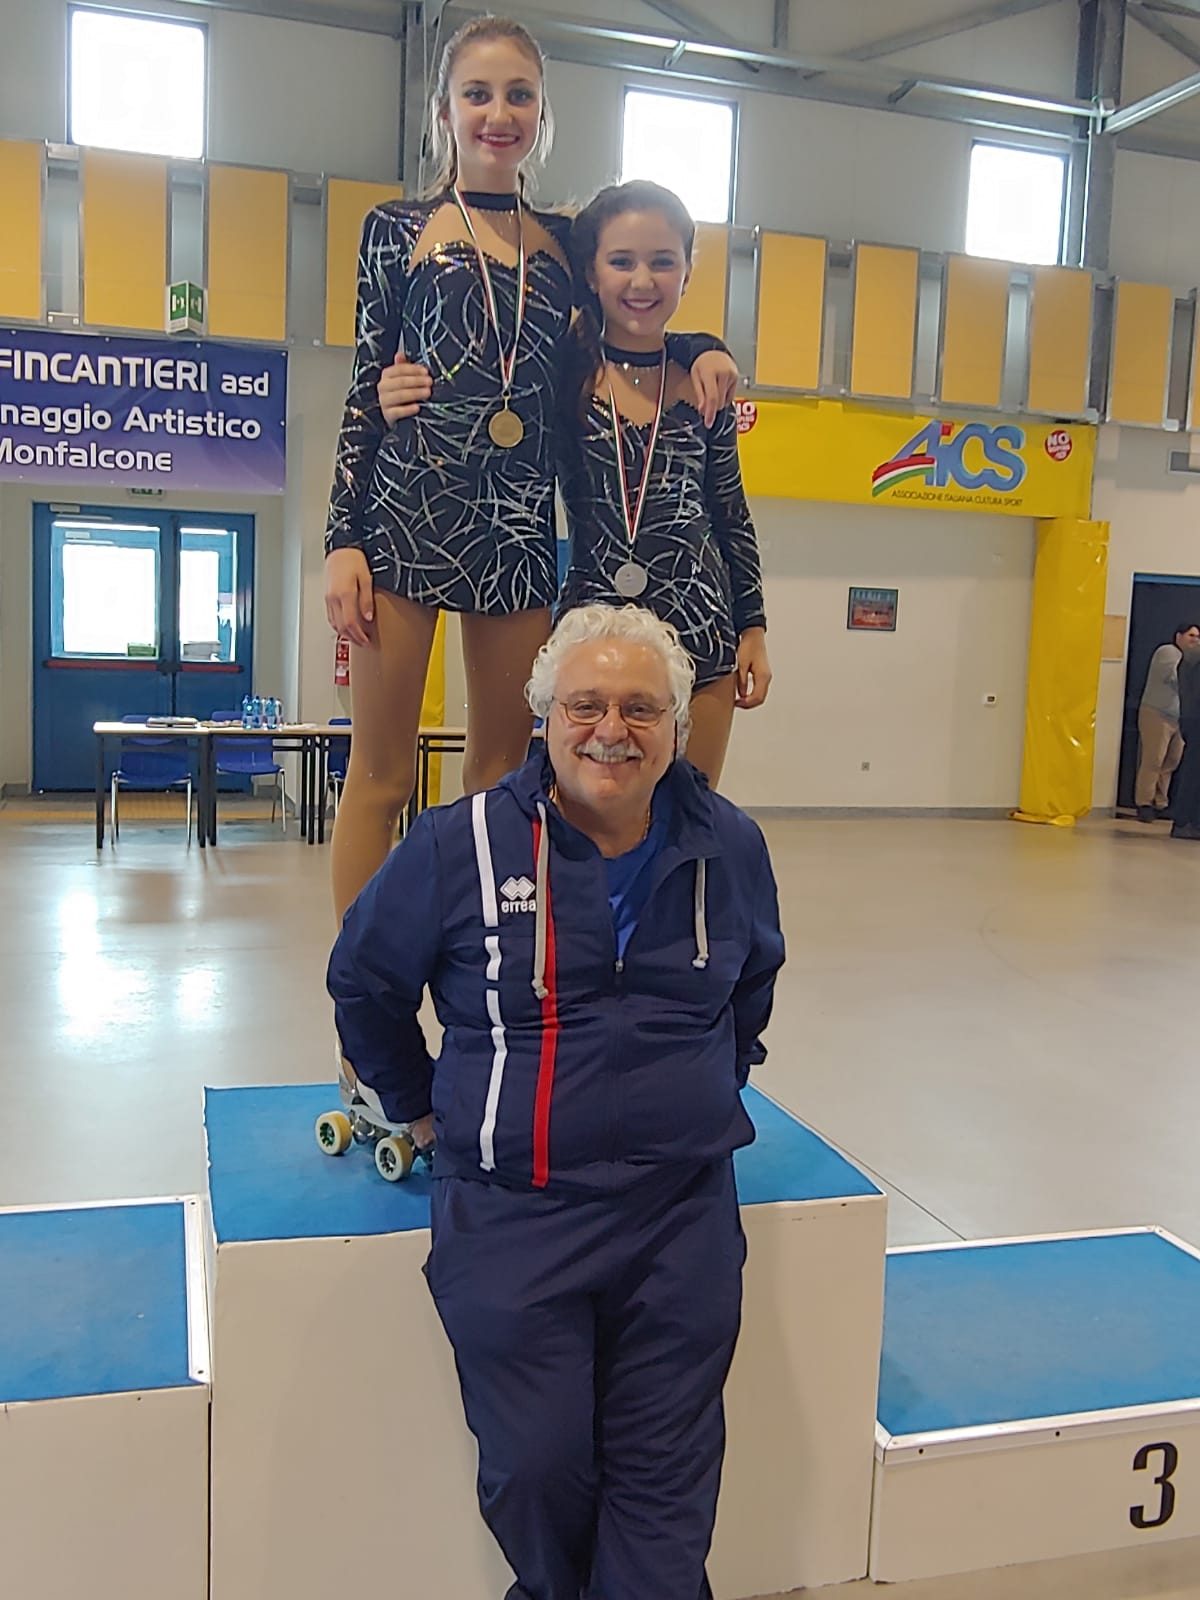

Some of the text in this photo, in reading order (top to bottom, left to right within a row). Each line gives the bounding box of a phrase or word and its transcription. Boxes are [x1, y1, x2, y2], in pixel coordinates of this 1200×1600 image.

[0, 349, 268, 396] FINCANTIERI asd
[0, 403, 261, 439] naggio Artistico
[1047, 433, 1070, 448] NO
[1129, 1441, 1178, 1529] 3
